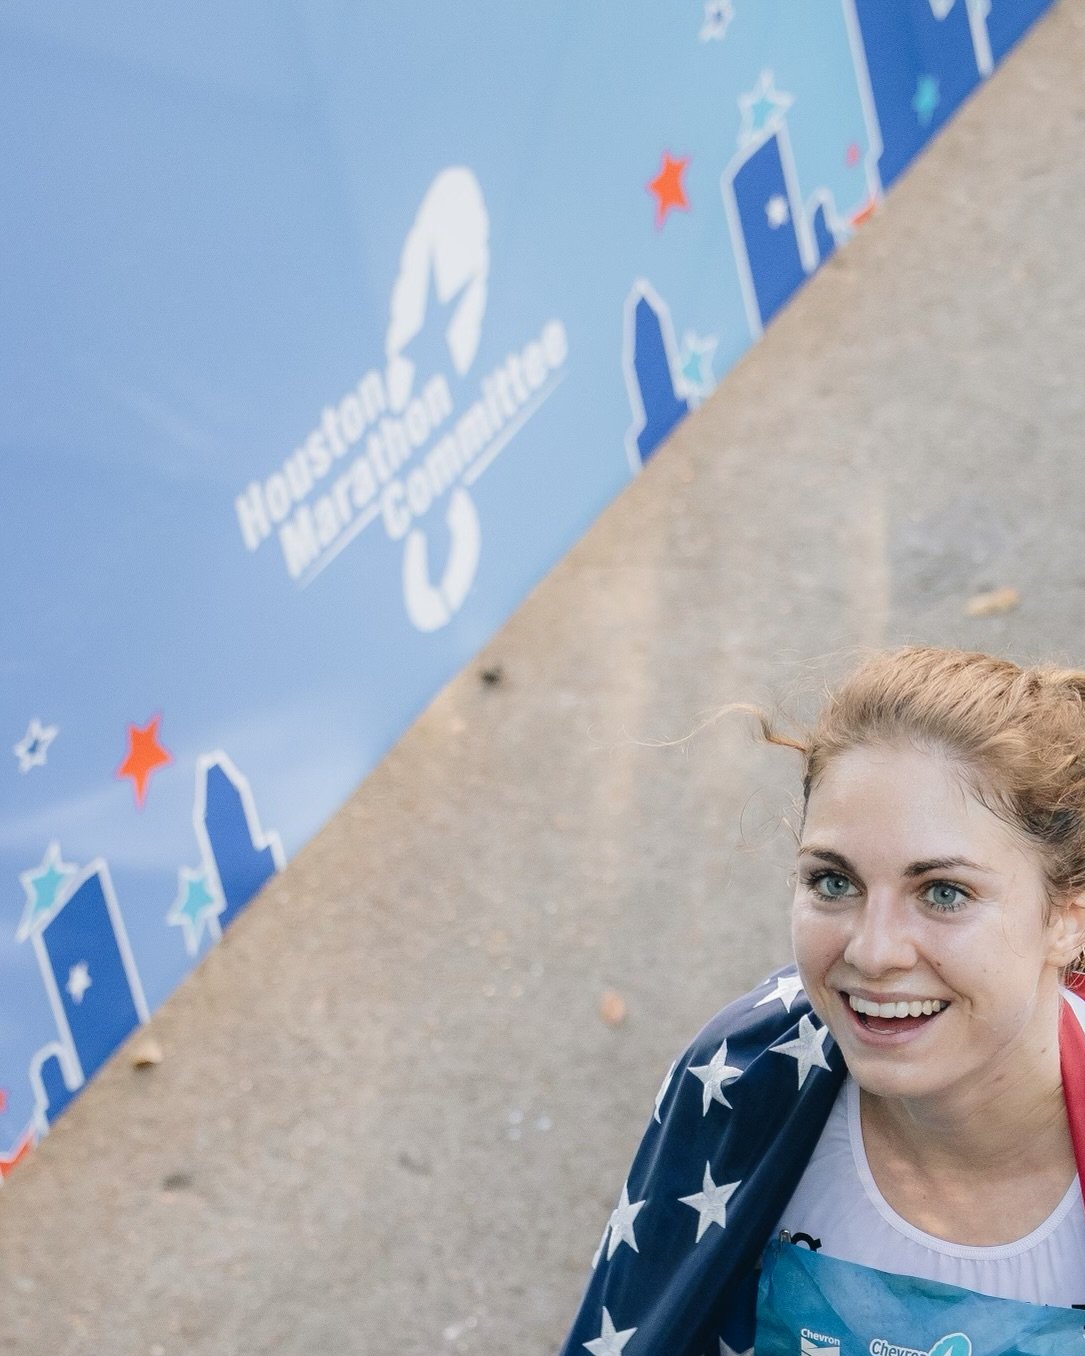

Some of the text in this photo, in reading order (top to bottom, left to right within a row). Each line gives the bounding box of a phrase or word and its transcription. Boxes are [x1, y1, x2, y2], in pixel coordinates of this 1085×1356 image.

[234, 369, 386, 552] Houston
[279, 373, 453, 580] Marathon
[380, 318, 569, 542] Committee
[800, 1328, 841, 1346] Chevron
